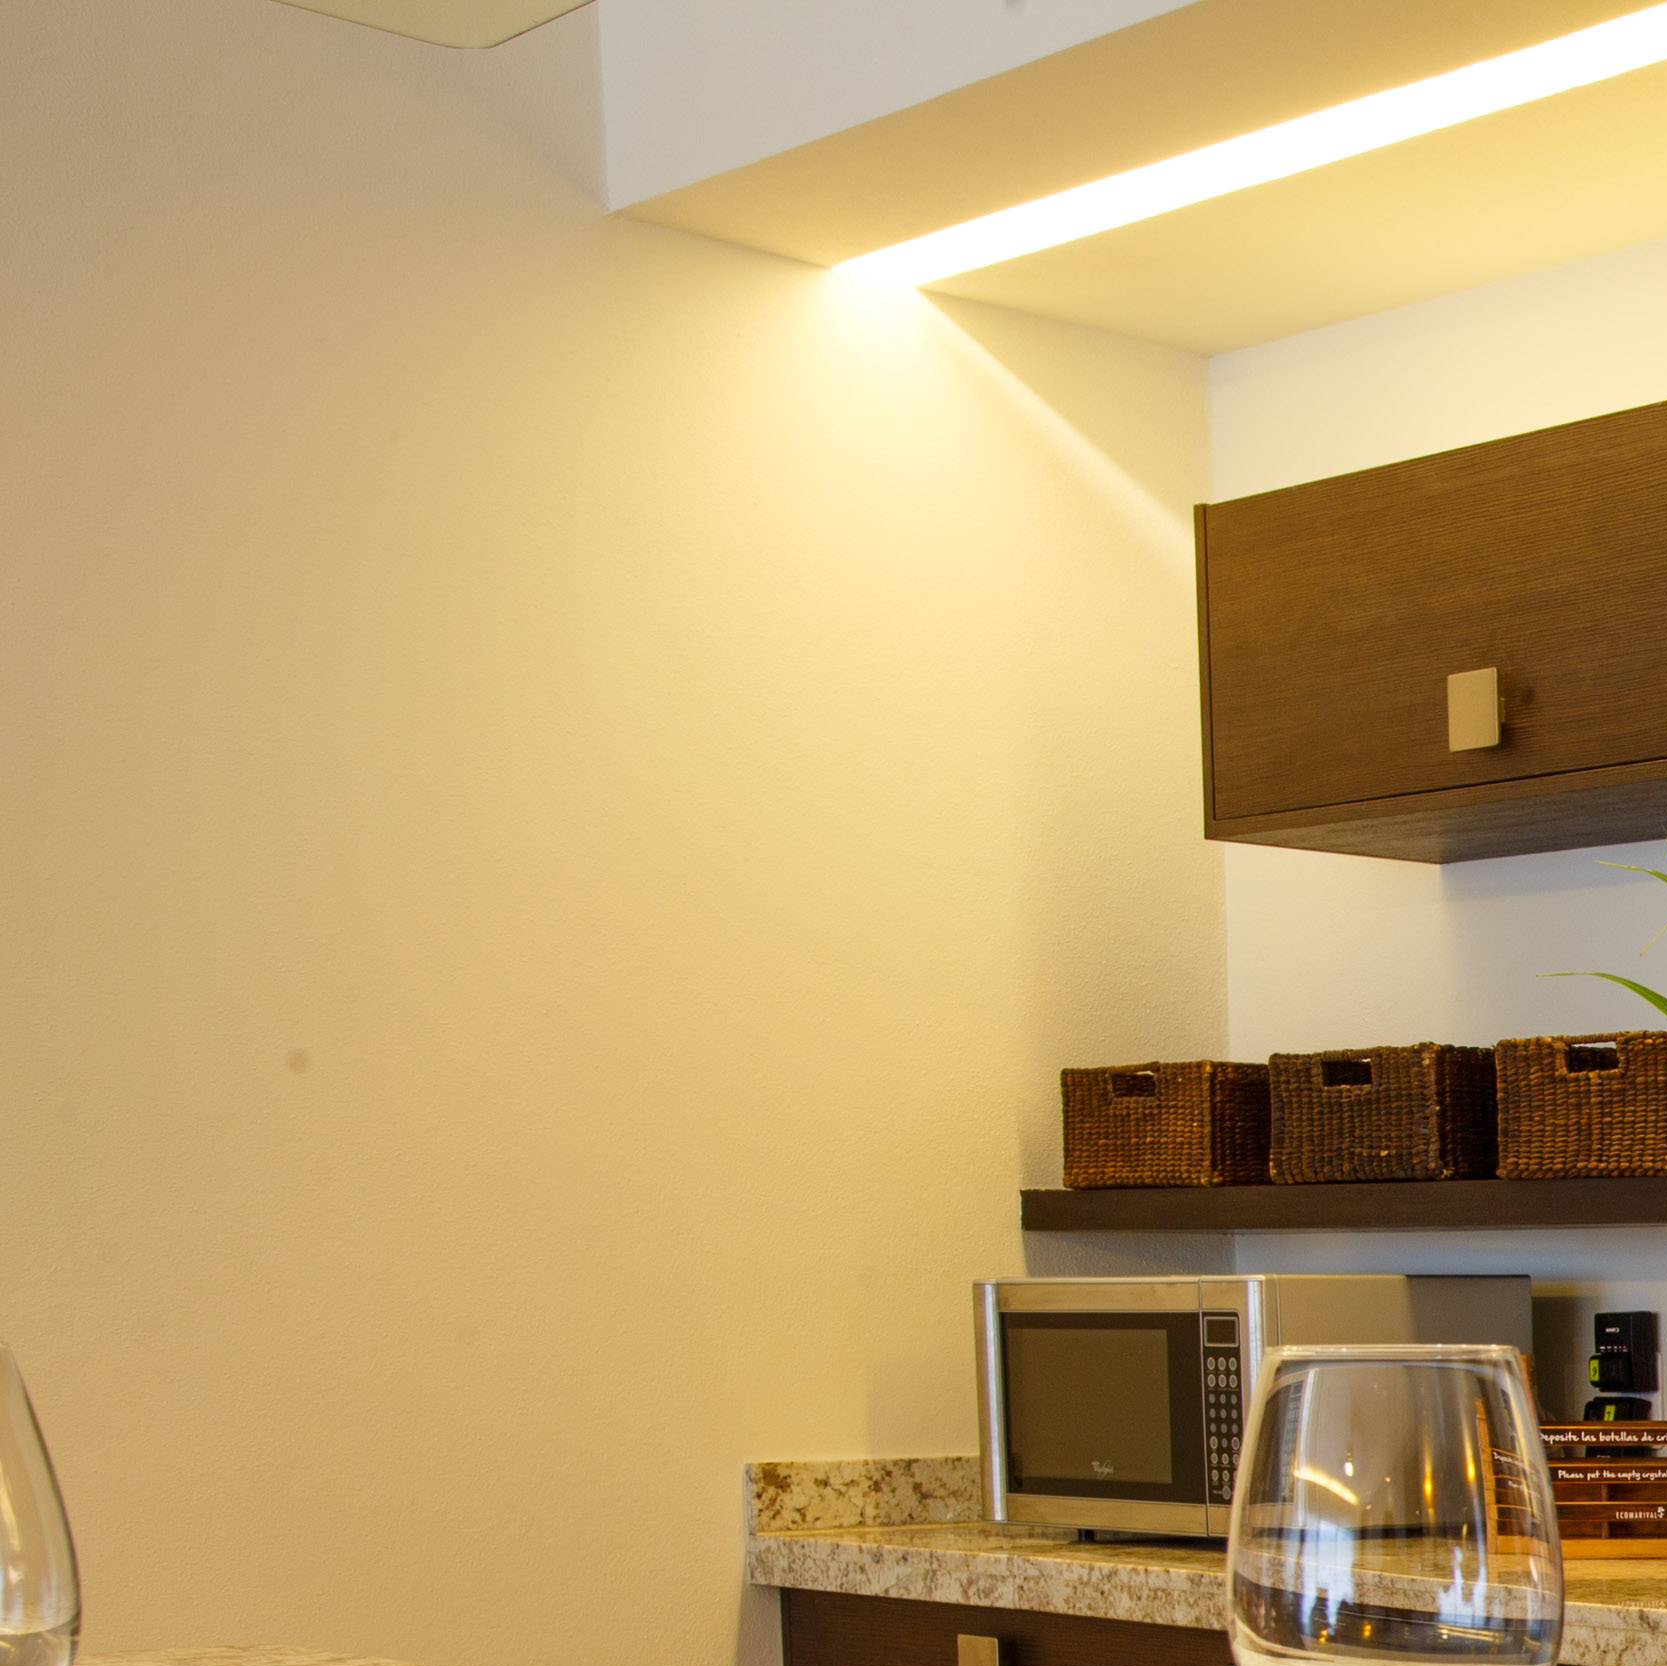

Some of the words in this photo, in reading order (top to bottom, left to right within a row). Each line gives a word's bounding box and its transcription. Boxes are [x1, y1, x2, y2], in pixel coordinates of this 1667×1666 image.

[1581, 1431, 1596, 1442] las
[1599, 1431, 1638, 1442] botellas
[1640, 1431, 1652, 1442] de
[1558, 1470, 1584, 1479] Please
[1587, 1470, 1600, 1481] put
[1602, 1470, 1616, 1479] the
[1617, 1470, 1640, 1481] empty
[1615, 1511, 1658, 1519] ECOMARIVAL
